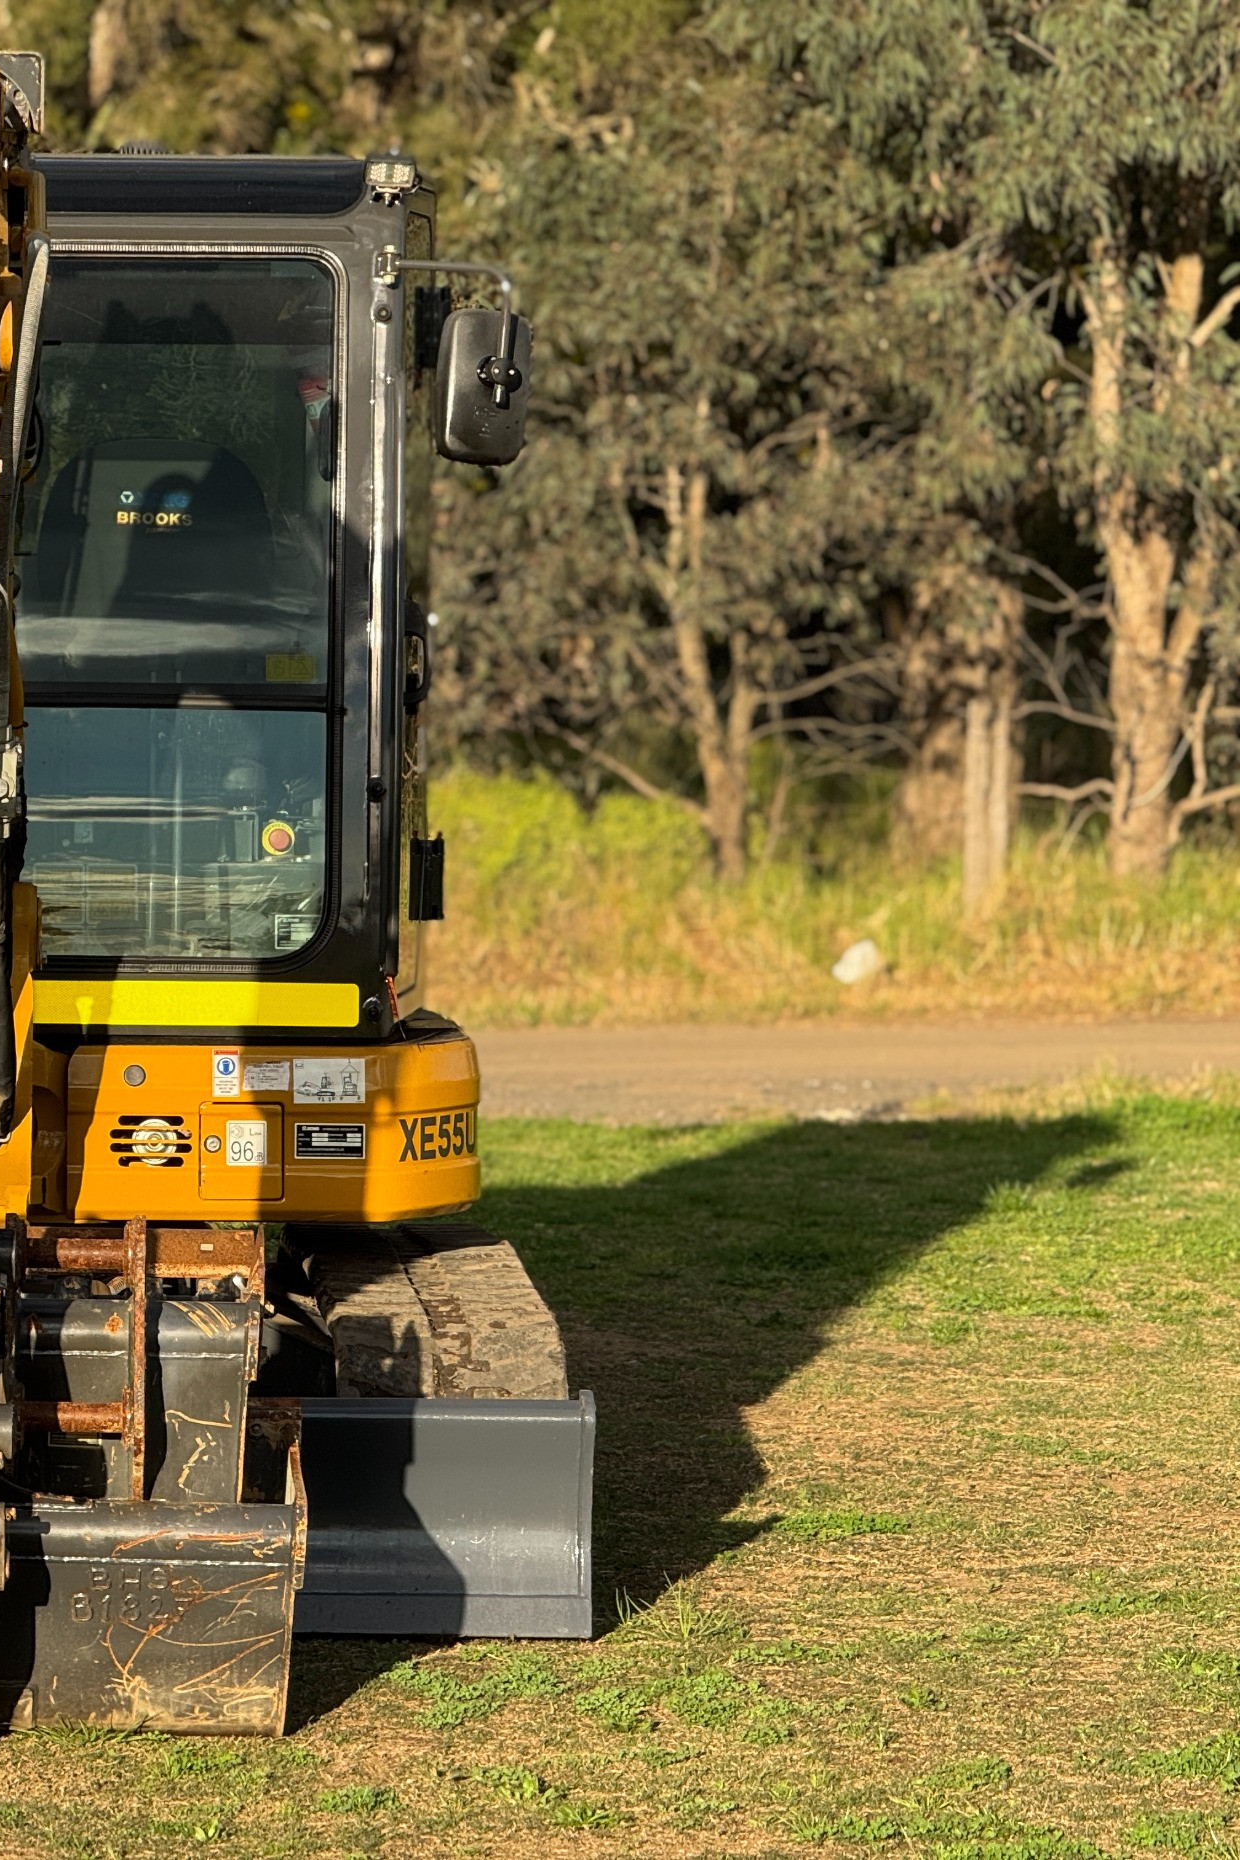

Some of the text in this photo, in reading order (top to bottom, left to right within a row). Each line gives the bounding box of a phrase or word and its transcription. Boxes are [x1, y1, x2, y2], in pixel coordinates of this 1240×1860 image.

[117, 511, 192, 525] BROOKS
[398, 1110, 476, 1162] XE55U
[231, 1141, 254, 1162] 96
